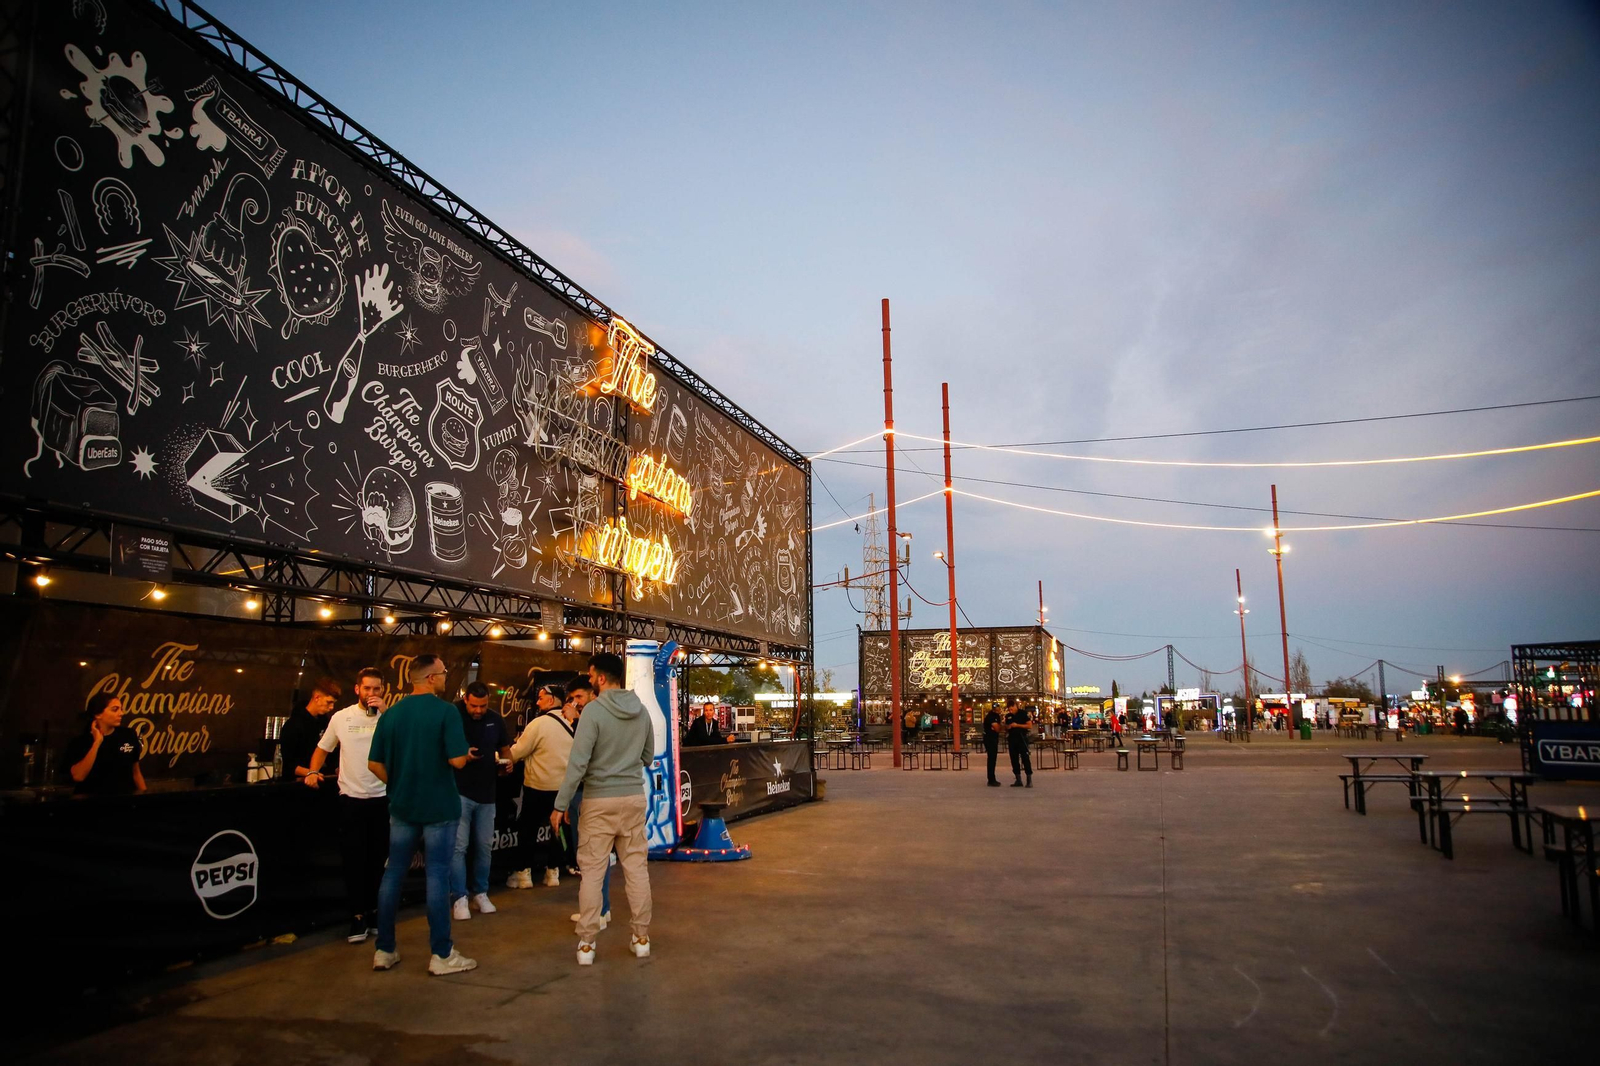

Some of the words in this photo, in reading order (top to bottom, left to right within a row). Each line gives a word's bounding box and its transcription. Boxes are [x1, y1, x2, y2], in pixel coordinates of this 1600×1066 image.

[219, 103, 264, 149] YBARRA
[291, 158, 352, 212] AMOR
[350, 211, 372, 258] DE
[295, 191, 354, 262] BURGER
[395, 205, 415, 226] EVEN
[415, 219, 428, 234] GOD
[428, 226, 446, 246] LOVE
[446, 239, 474, 264] BURGERS
[29, 287, 167, 354] BURGERNÍVORO
[271, 350, 332, 390] COOL
[377, 350, 449, 379] BURGERHERO
[477, 355, 497, 392] YBARRA
[601, 317, 657, 409] The
[392, 387, 423, 426] The
[445, 390, 474, 419] ROUTE
[361, 380, 435, 469] Champions
[482, 423, 519, 450] YUMMY
[87, 447, 118, 459] UberEats
[365, 417, 418, 478] Burger
[433, 515, 460, 527] Heineken
[151, 545, 169, 553] TARJETA
[696, 573, 714, 599] COOL
[141, 641, 199, 689] The
[766, 777, 791, 795] Heineken
[195, 861, 255, 889] PEPSI
